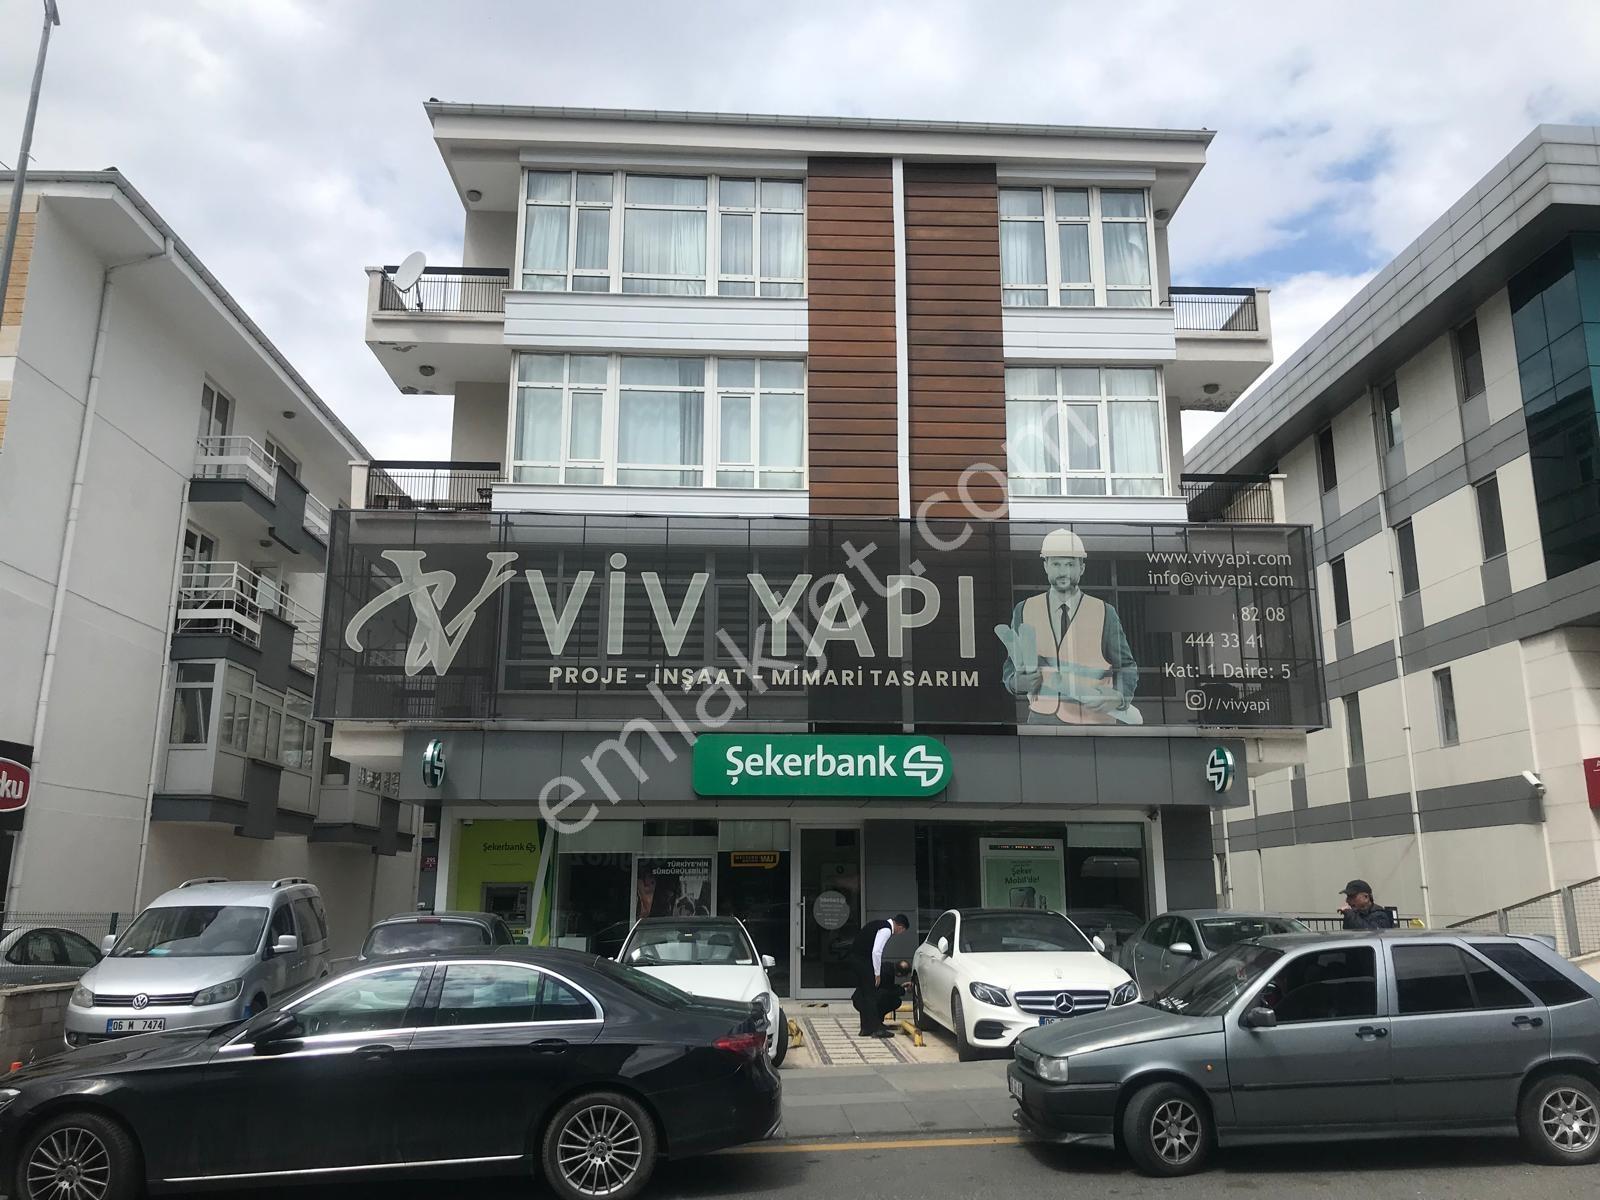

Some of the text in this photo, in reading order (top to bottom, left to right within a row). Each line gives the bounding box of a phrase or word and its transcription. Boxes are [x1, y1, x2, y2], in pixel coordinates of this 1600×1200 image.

[1146, 550, 1292, 568] www.vivyapi.com
[1148, 571, 1294, 589] info@vivyapi.com
[524, 552, 710, 657] VİV
[746, 573, 977, 659] YAPI
[1240, 607, 1286, 622] 82 08
[1185, 633, 1264, 648] 444 33 41
[548, 666, 628, 685] PROJE
[653, 663, 743, 691] İNŞAAT
[771, 664, 864, 687] MİMARİ
[869, 669, 979, 688] TASARIM
[1164, 662, 1291, 679] Kat: 1 Daire: 5
[726, 743, 898, 785] Şekerbank
[482, 842, 525, 852] Şekerbank
[113, 1021, 123, 1031] 06
[142, 1020, 163, 1030] 7474
